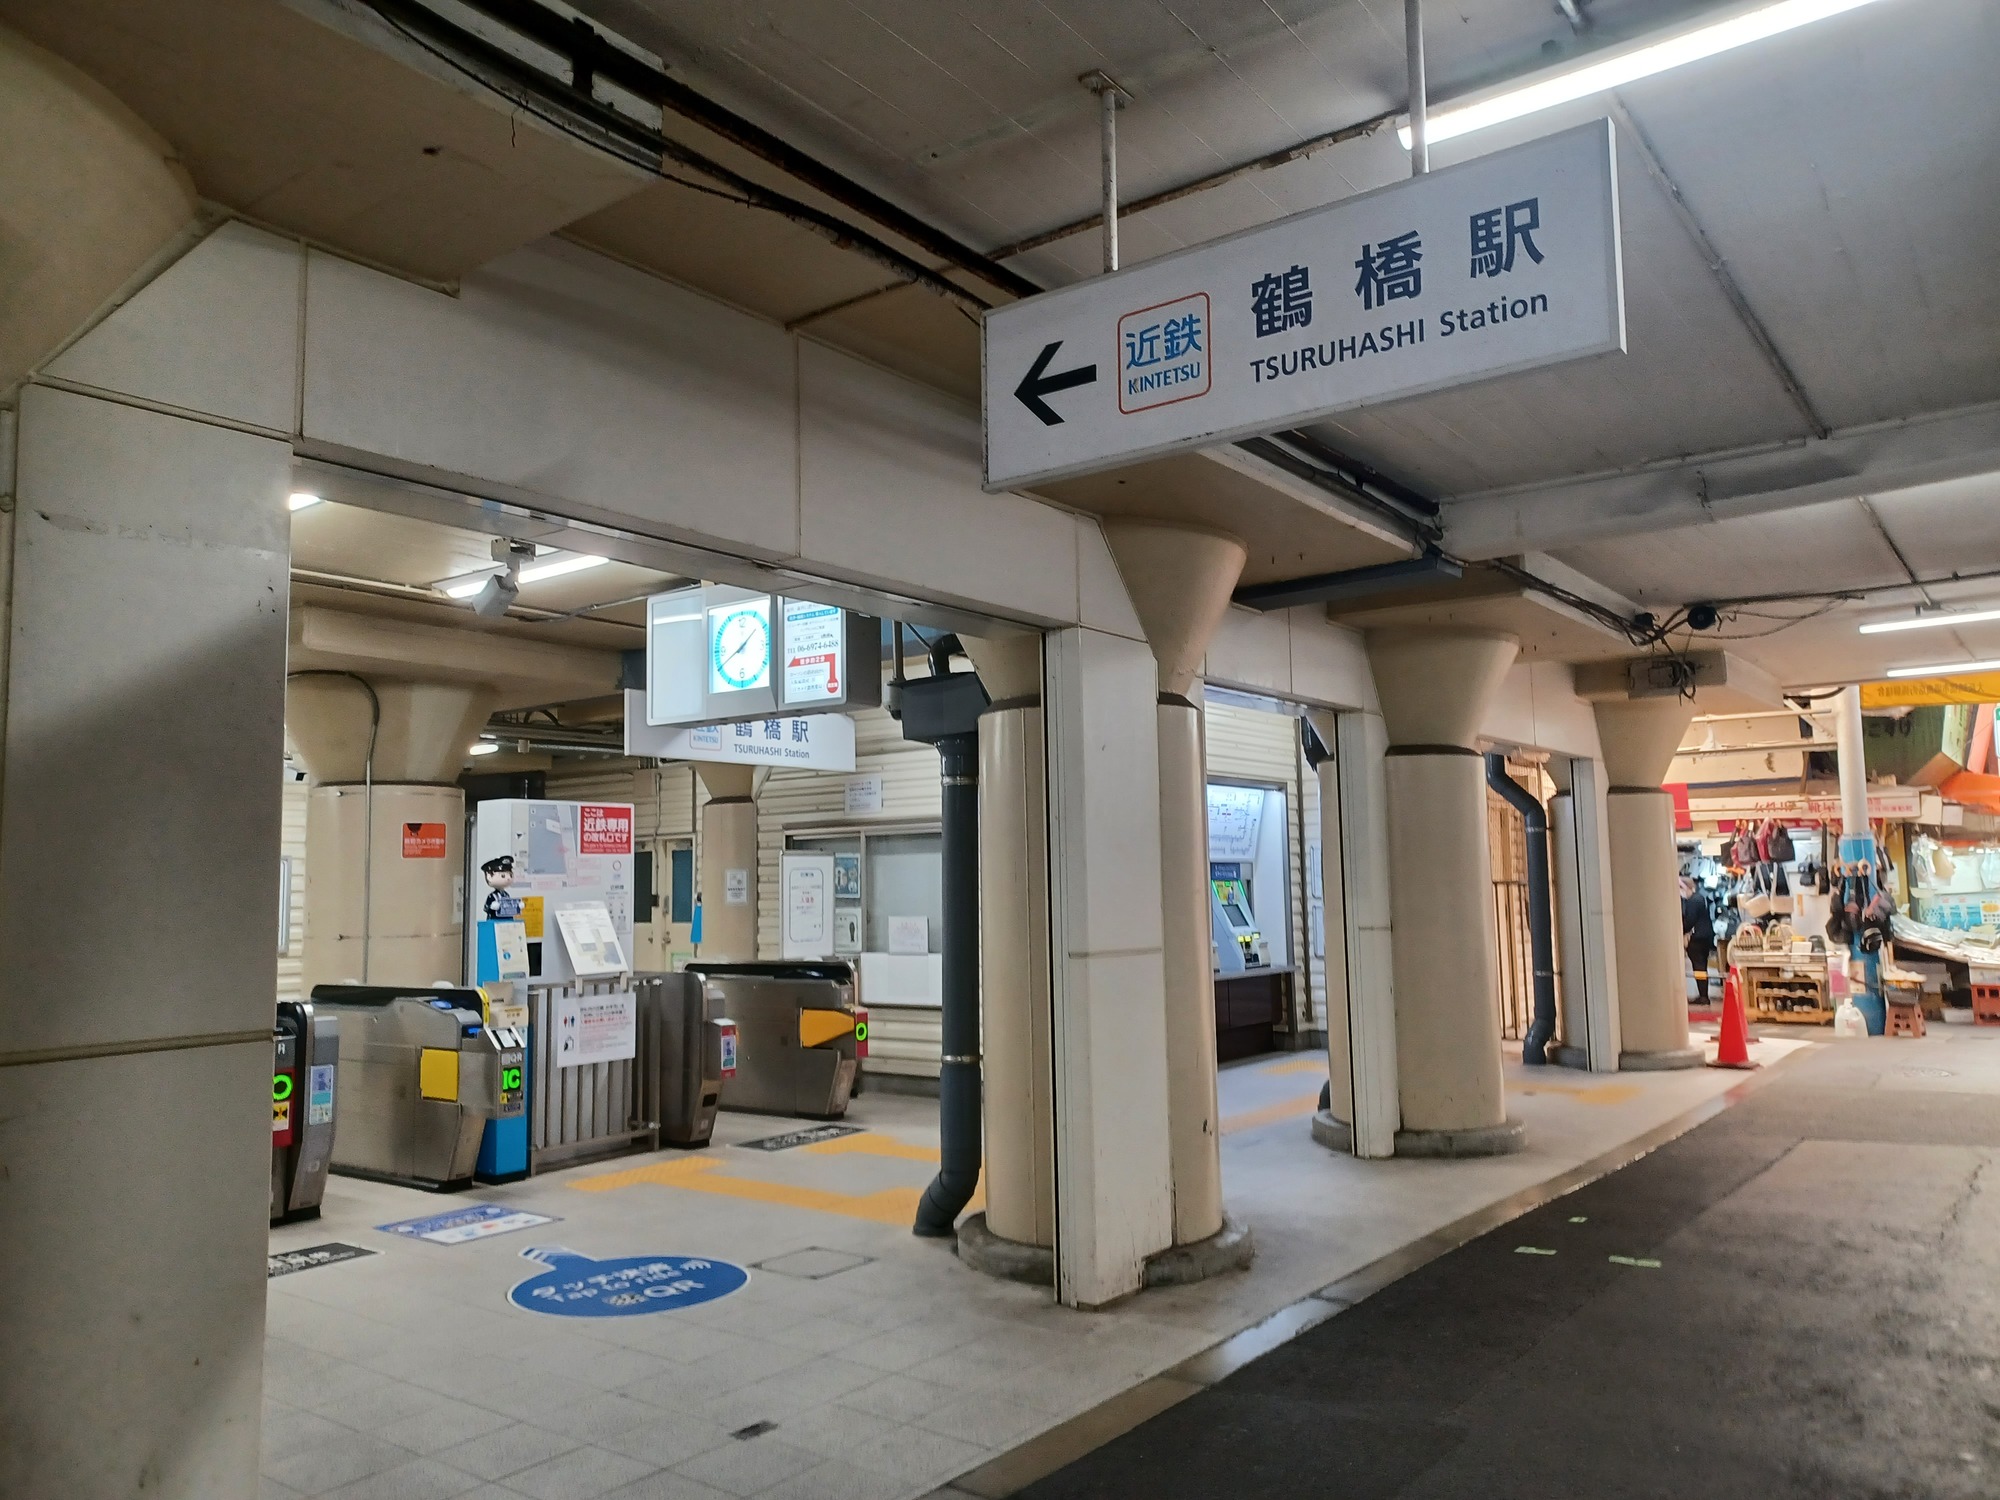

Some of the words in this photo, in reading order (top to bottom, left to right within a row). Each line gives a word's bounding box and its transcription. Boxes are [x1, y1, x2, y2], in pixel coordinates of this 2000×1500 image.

[1126, 313, 1202, 370] 近鉄
[1249, 318, 1426, 384] TSURUHASHI
[1440, 292, 1549, 338] Station
[1128, 361, 1201, 395] KINTETSU
[733, 743, 782, 757] TSURUHASHI
[784, 748, 811, 760] Station
[583, 807, 604, 818] ここは
[583, 817, 629, 833] 近鉄専用
[583, 832, 629, 843] の改札口です
[510, 1052, 523, 1064] QR
[502, 1068, 520, 1090] IC
[643, 1279, 706, 1298] QR
